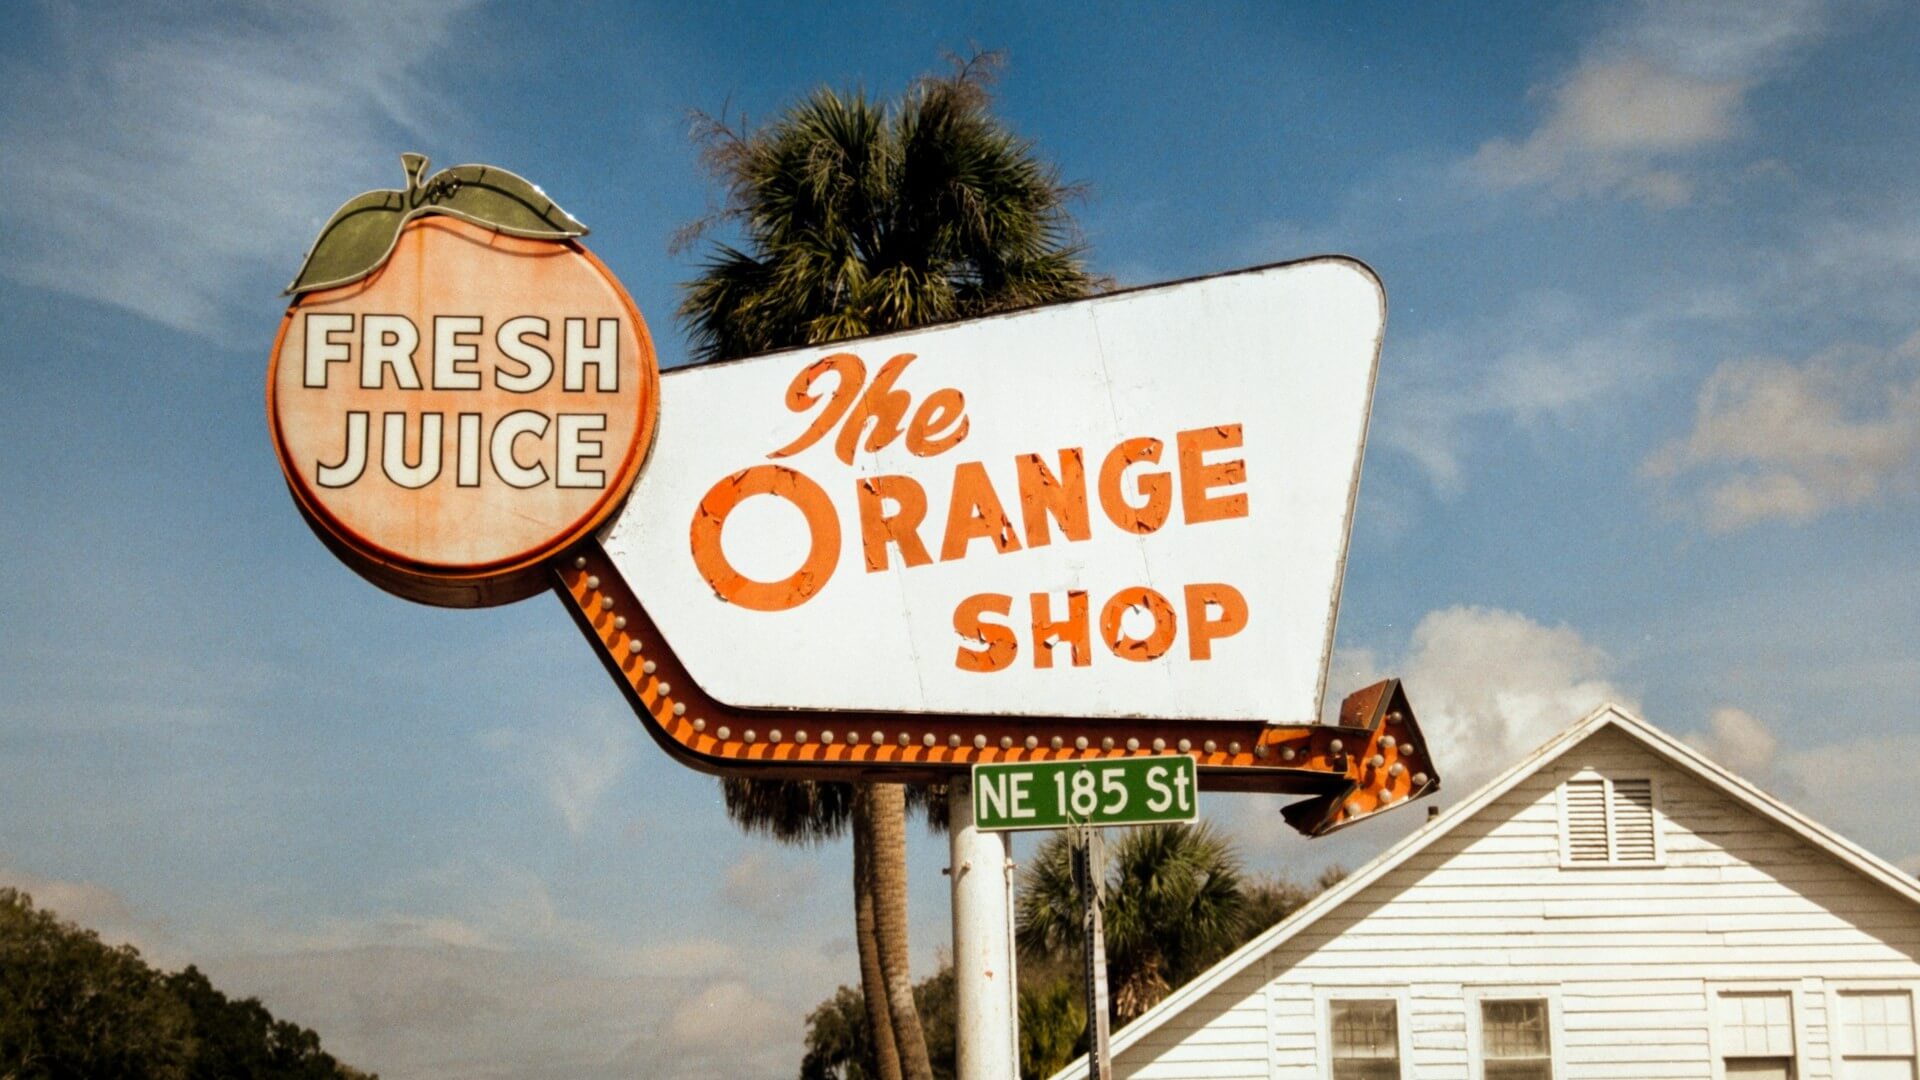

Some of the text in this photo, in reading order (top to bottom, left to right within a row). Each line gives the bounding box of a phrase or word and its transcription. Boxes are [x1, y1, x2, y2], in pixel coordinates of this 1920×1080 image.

[302, 312, 620, 393] FRESH
[316, 409, 607, 490] JUICE
[766, 352, 970, 466] The
[689, 423, 1249, 612] ORANGE
[952, 582, 1249, 674] SHOP
[978, 765, 1190, 820] NE 185 St
